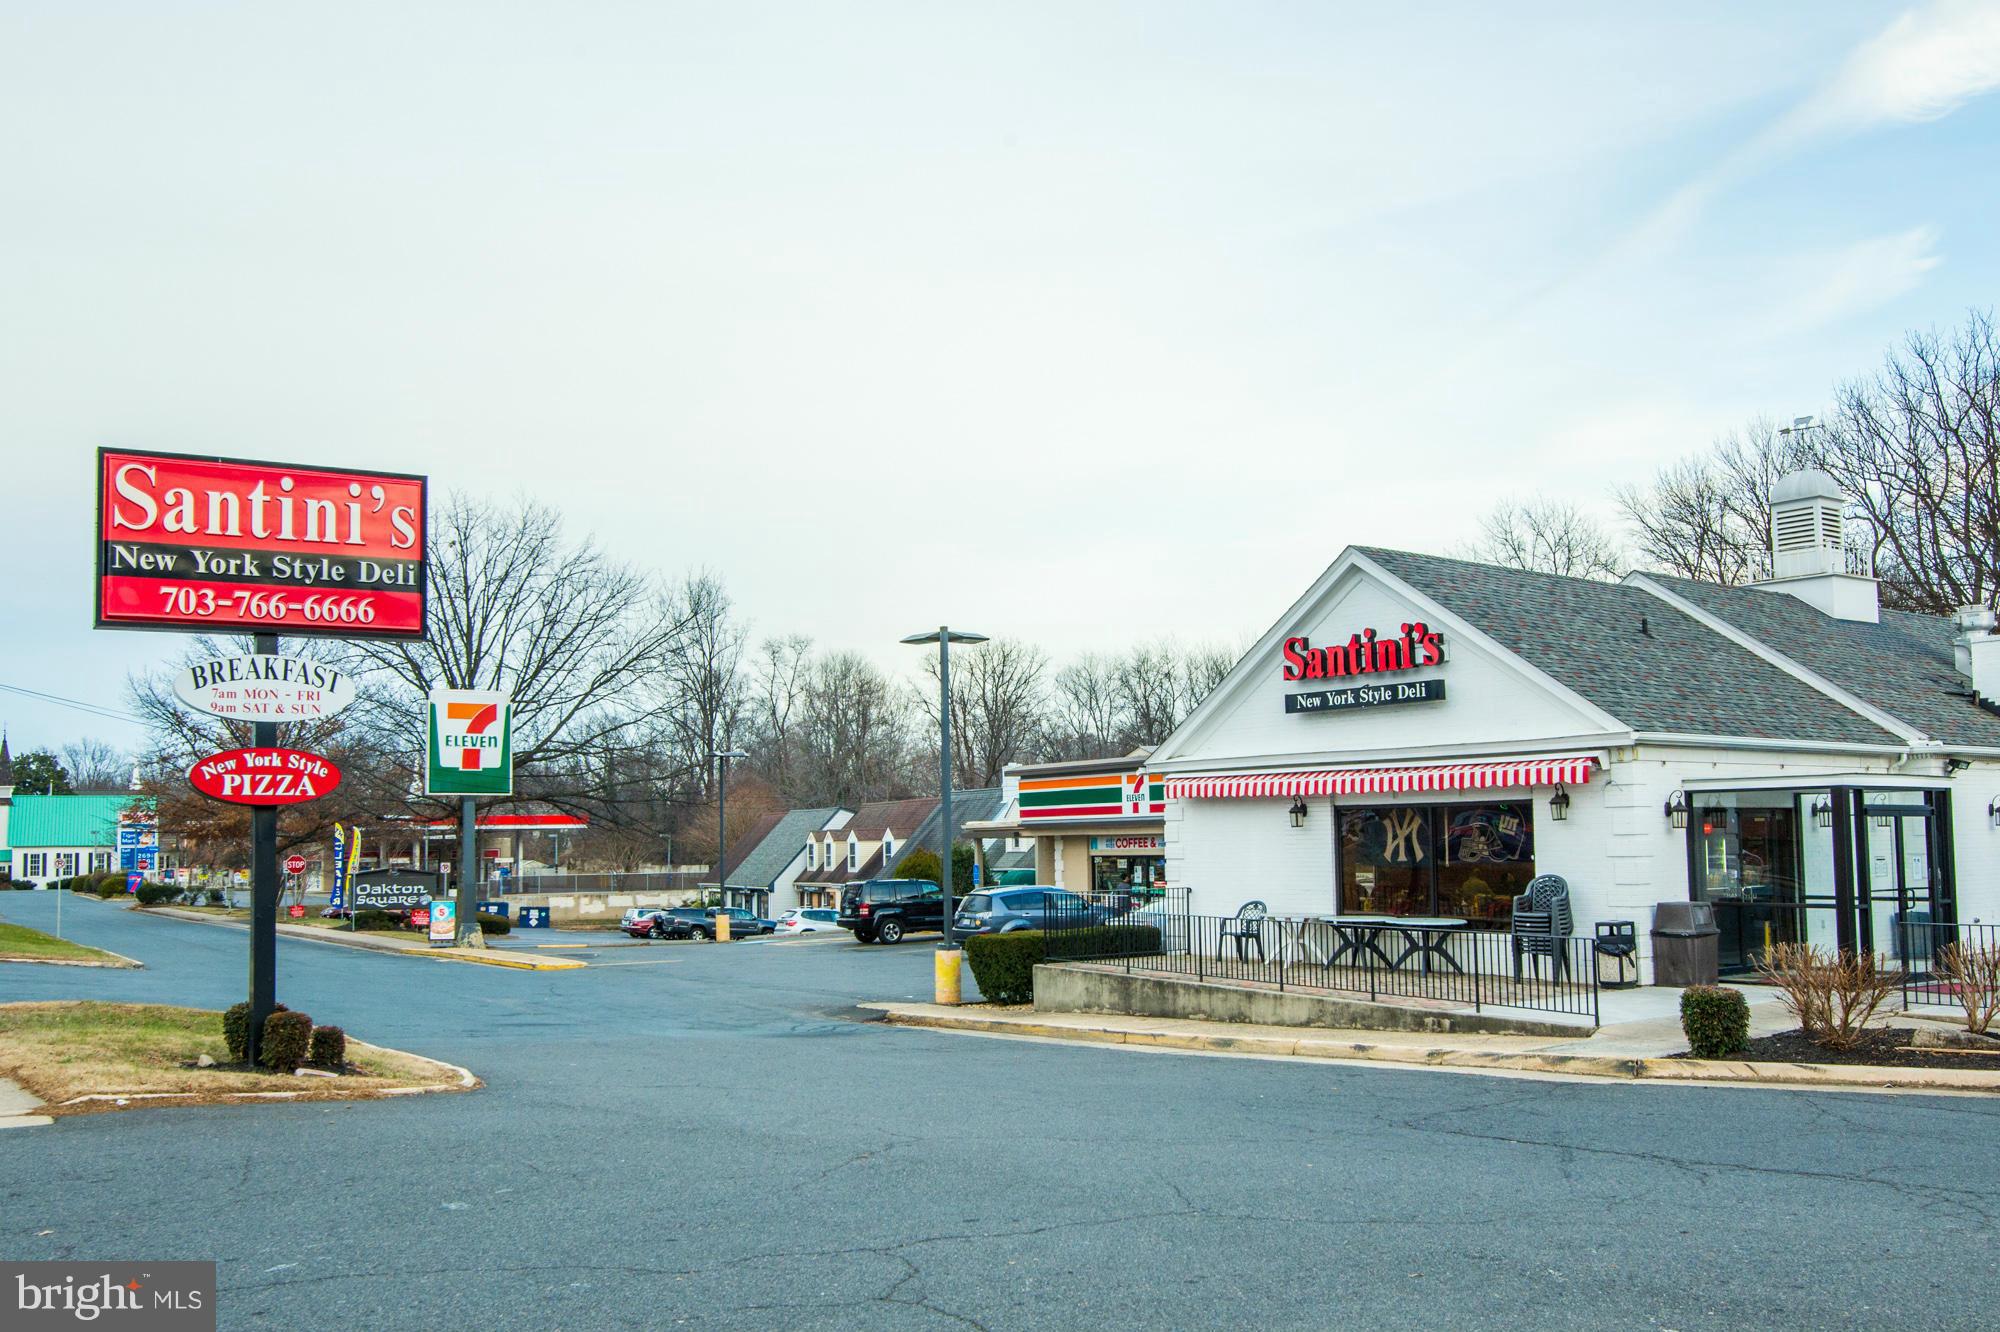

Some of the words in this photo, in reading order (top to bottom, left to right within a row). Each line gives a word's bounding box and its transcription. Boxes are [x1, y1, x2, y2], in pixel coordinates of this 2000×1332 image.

[113, 463, 416, 549] Santini's
[112, 544, 177, 572] New
[190, 550, 261, 577] York
[272, 555, 345, 584] Style
[357, 560, 416, 586] Deli
[159, 585, 375, 623] 703-766-6666
[1283, 622, 1445, 681] Santini's
[190, 657, 344, 694] BREAKFAST
[211, 687, 237, 699] 7am
[244, 688, 279, 699] MON
[297, 690, 321, 701] FRI
[1297, 695, 1322, 709] New
[1326, 691, 1355, 707] York
[1359, 687, 1392, 705] Style
[1397, 683, 1427, 699] Deli
[210, 701, 237, 713] 9am
[242, 703, 270, 714] SAT
[275, 703, 286, 714] &
[291, 703, 321, 714] SUN
[200, 758, 237, 780] New
[243, 752, 282, 768] York
[287, 753, 328, 778] Style
[221, 774, 316, 796] PIZZA
[1115, 837, 1149, 849] COFFEE
[1149, 837, 1157, 849] &
[287, 861, 305, 869] STOP
[355, 883, 429, 895] Oakton
